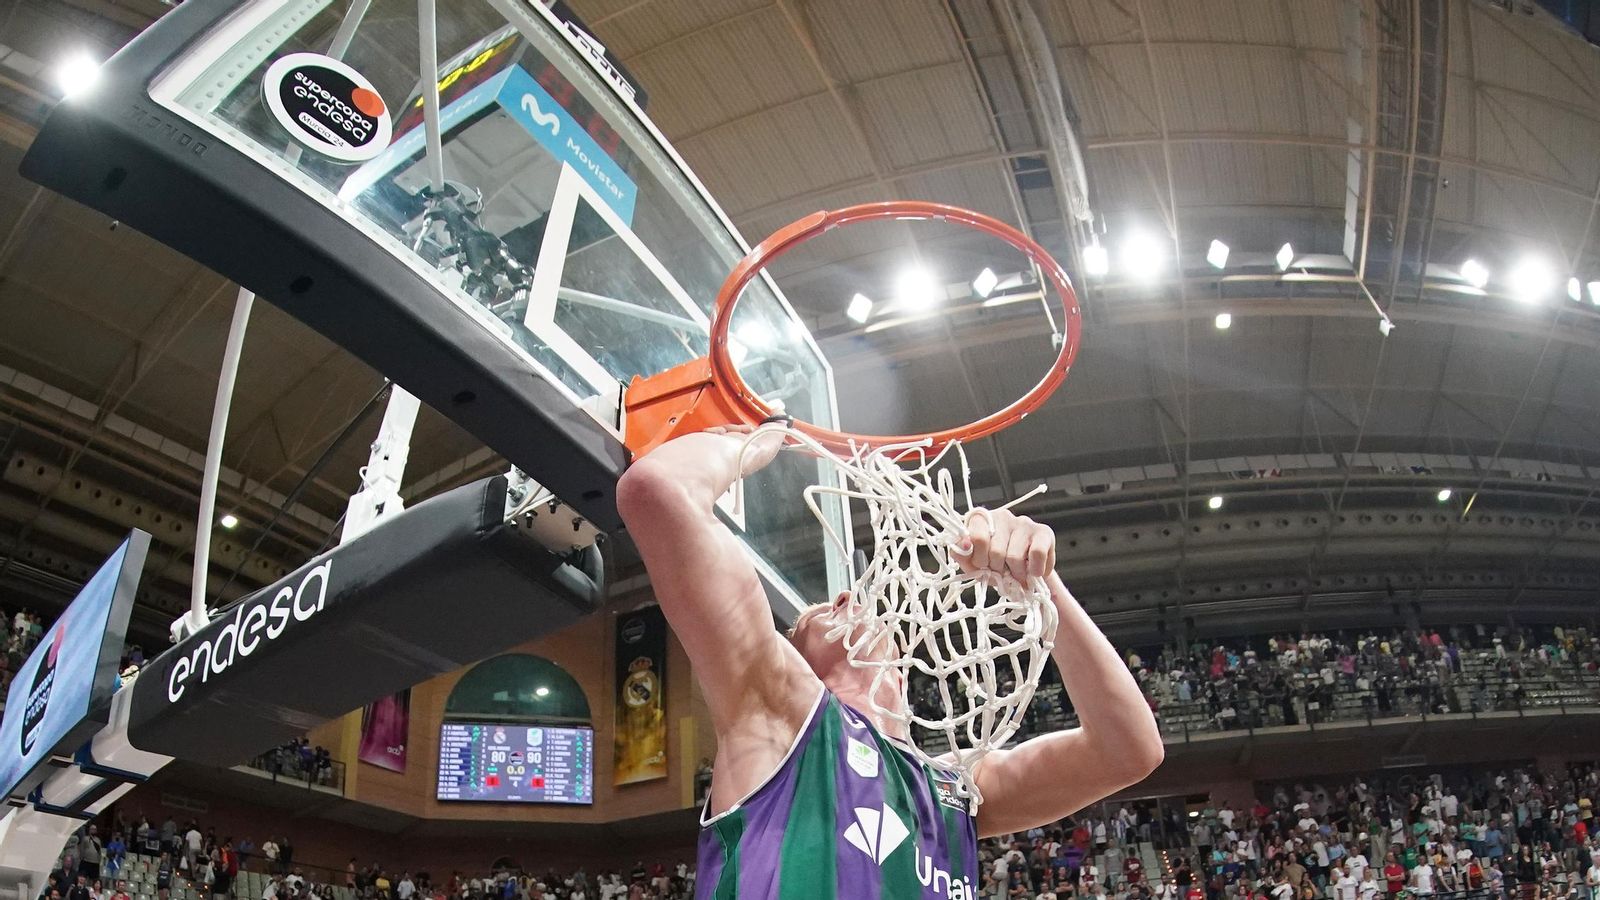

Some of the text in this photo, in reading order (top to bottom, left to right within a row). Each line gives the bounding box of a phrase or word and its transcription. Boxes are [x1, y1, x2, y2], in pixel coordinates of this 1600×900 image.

[293, 85, 367, 141] endesa
[294, 71, 373, 131] supercopa
[567, 136, 624, 199] Movistar
[168, 558, 333, 703] endesa
[491, 751, 506, 763] 80
[506, 765, 525, 775] 0.0
[527, 752, 542, 764] 90
[512, 780, 518, 788] 4
